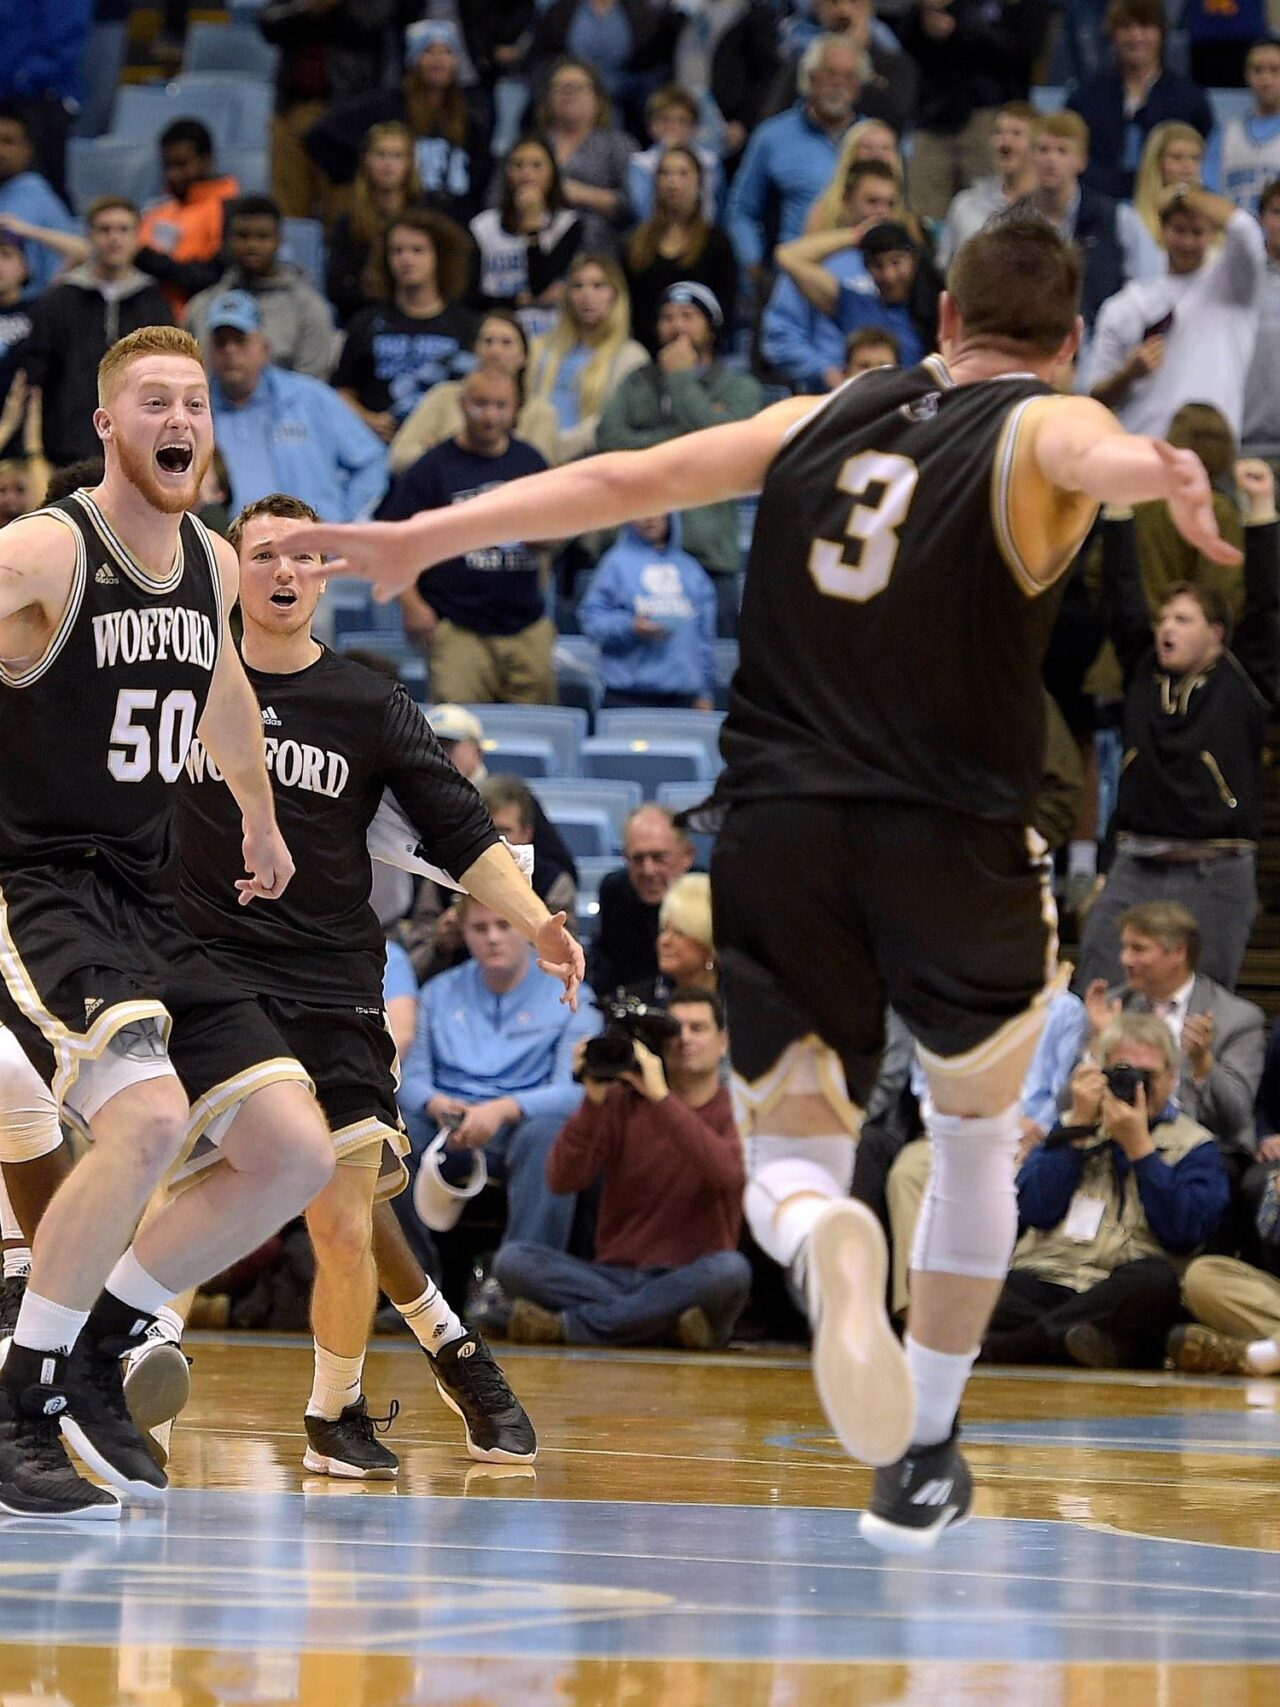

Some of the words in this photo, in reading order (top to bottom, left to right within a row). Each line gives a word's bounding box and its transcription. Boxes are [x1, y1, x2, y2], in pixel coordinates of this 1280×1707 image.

[807, 449, 919, 602] 3
[92, 606, 216, 671] WOFFORD
[107, 688, 197, 784] 50
